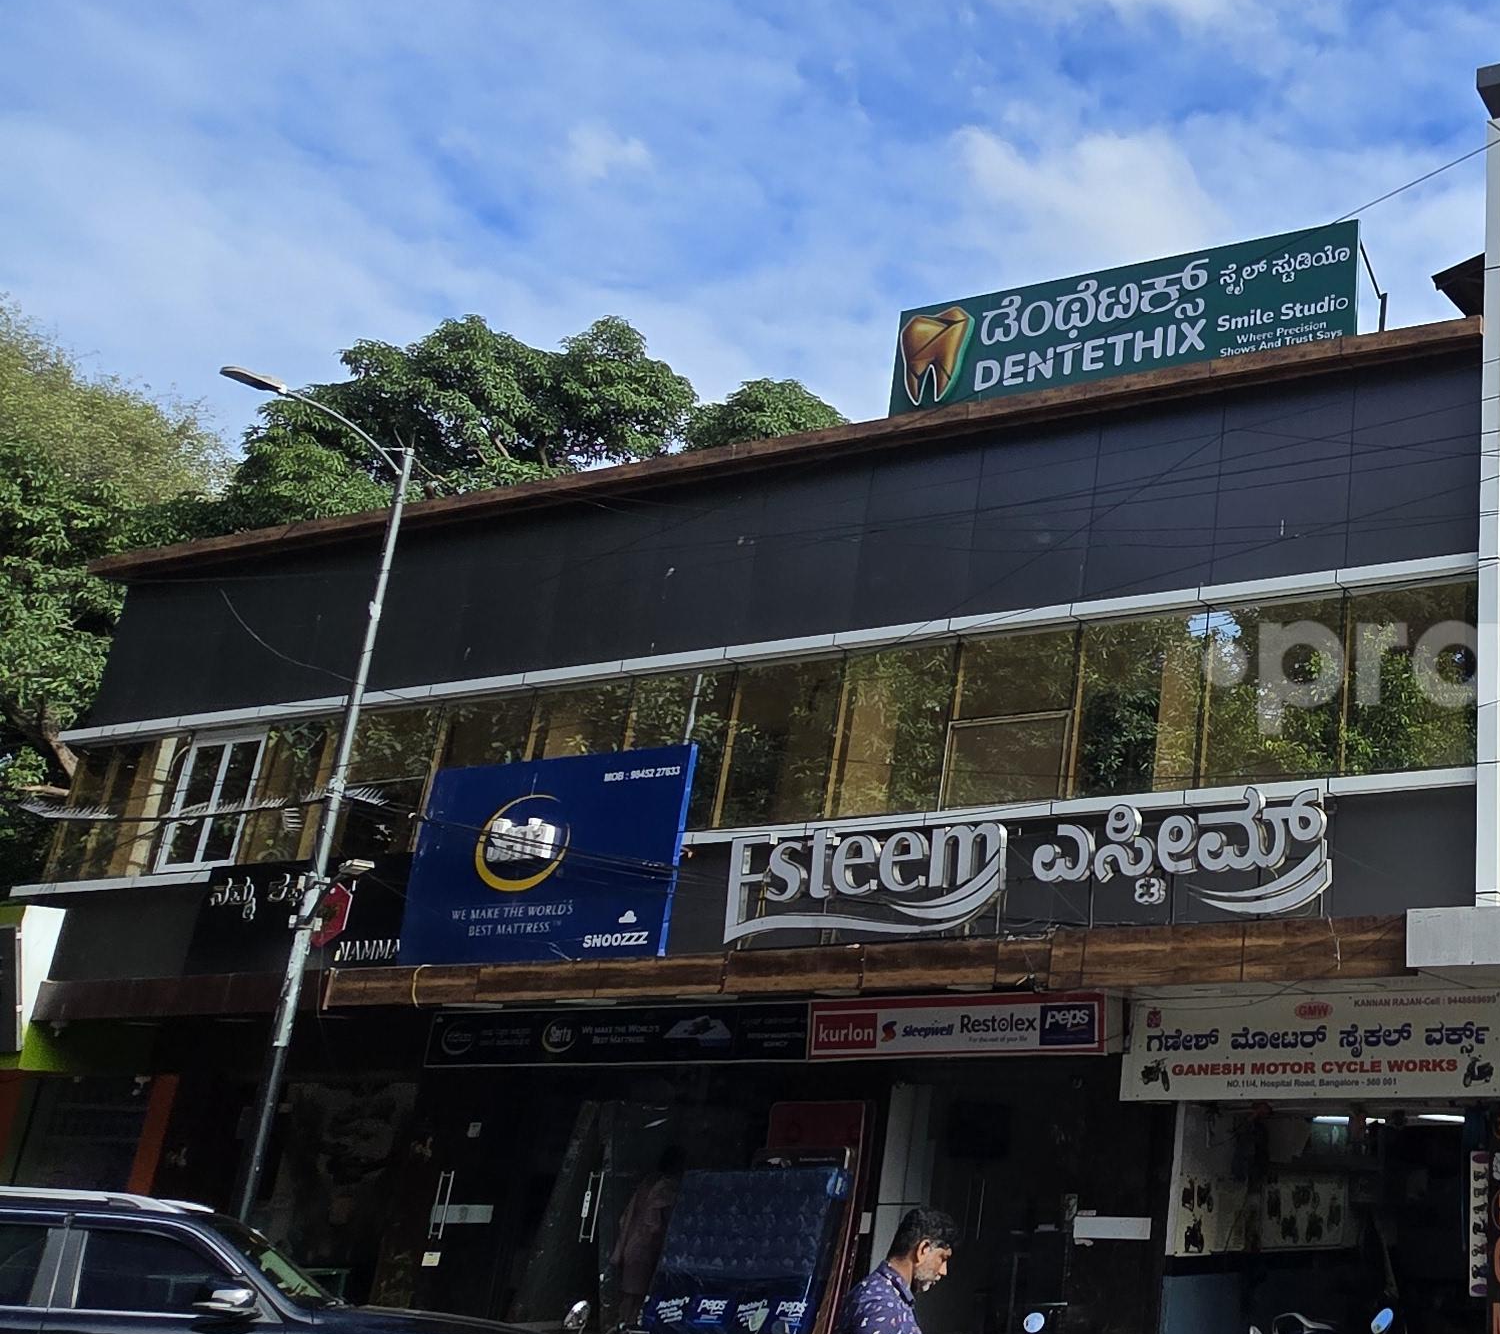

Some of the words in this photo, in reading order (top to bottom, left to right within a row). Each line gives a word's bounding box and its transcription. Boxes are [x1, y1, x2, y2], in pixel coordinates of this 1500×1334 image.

[1220, 259, 1267, 295] ಸ್ಮೈಲ್
[1217, 309, 1274, 332] Smile
[1280, 294, 1348, 320] Studio
[1236, 331, 1273, 344] Where
[1277, 321, 1327, 337] Precision
[1220, 344, 1256, 358] Shows
[1259, 338, 1281, 352] And
[1285, 333, 1313, 346] Trust
[1317, 329, 1343, 341] Says
[974, 318, 1207, 392] DENTETHIX
[1032, 786, 1328, 905] ಎಸ್ಟೀಮ್
[724, 822, 1007, 944] Esteem
[452, 909, 466, 920] WE
[471, 908, 500, 920] MAKE
[503, 906, 525, 918] THE
[468, 925, 492, 937] BEST
[582, 931, 649, 948] SNOOZZZ
[1300, 1004, 1329, 1017] GMW
[1354, 998, 1391, 1008] KANNAN
[902, 1021, 953, 1038] Sleepwell
[960, 1012, 1037, 1034] Restolex
[1045, 1010, 1089, 1029] peps
[819, 1023, 873, 1043] kurlon
[1146, 1028, 1219, 1052] ಗಣೇಶ್
[1339, 1022, 1412, 1058] ಸೈಕಲ್
[1172, 1062, 1245, 1076] GANESH
[1250, 1061, 1316, 1075] MOTOR
[1321, 1060, 1382, 1074] CYCLE
[1387, 1058, 1458, 1073] WORKS
[1260, 1079, 1292, 1089] Hospital
[1319, 1077, 1359, 1087] Bangalore
